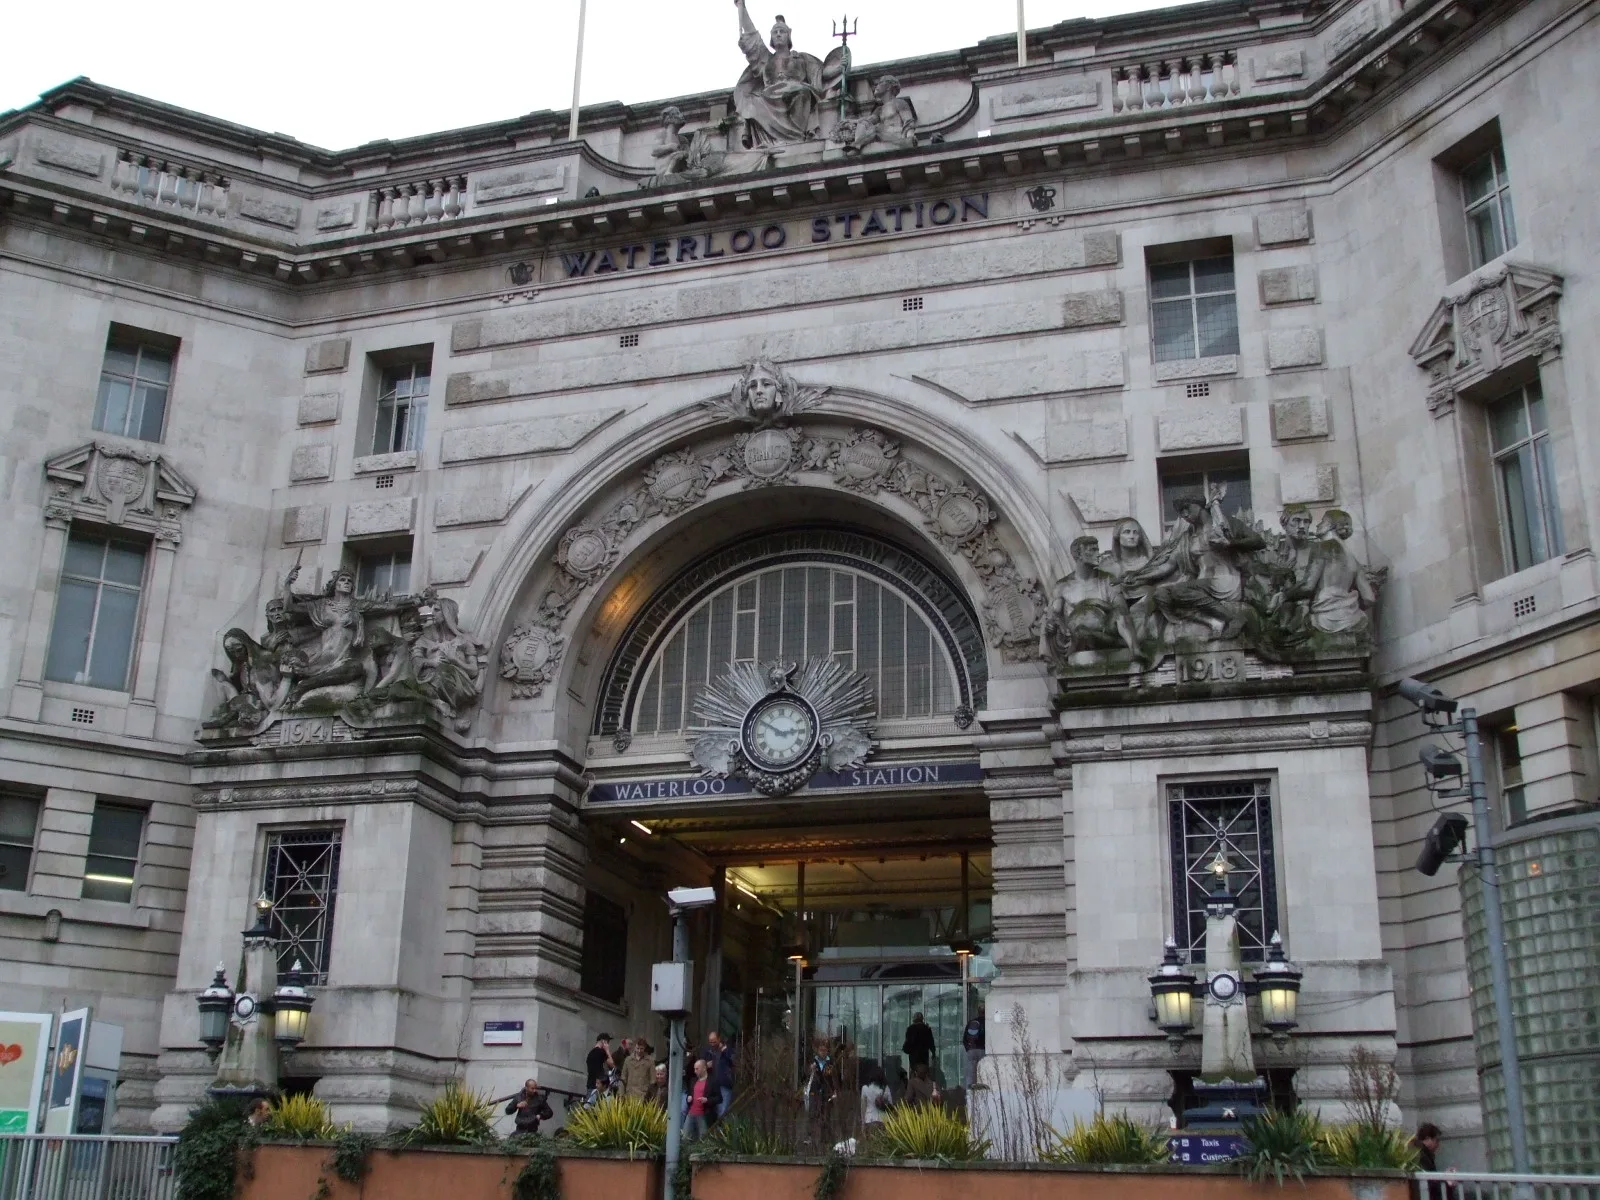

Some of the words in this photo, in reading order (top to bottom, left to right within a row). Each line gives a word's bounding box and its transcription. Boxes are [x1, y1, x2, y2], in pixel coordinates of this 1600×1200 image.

[560, 223, 787, 278] WATERLOO
[811, 193, 990, 243] STATION
[1179, 656, 1239, 681] 1918
[283, 719, 330, 745] 1914
[615, 779, 726, 801] WATERLOO
[852, 766, 940, 787] STATION
[1200, 1138, 1220, 1147] Taxis
